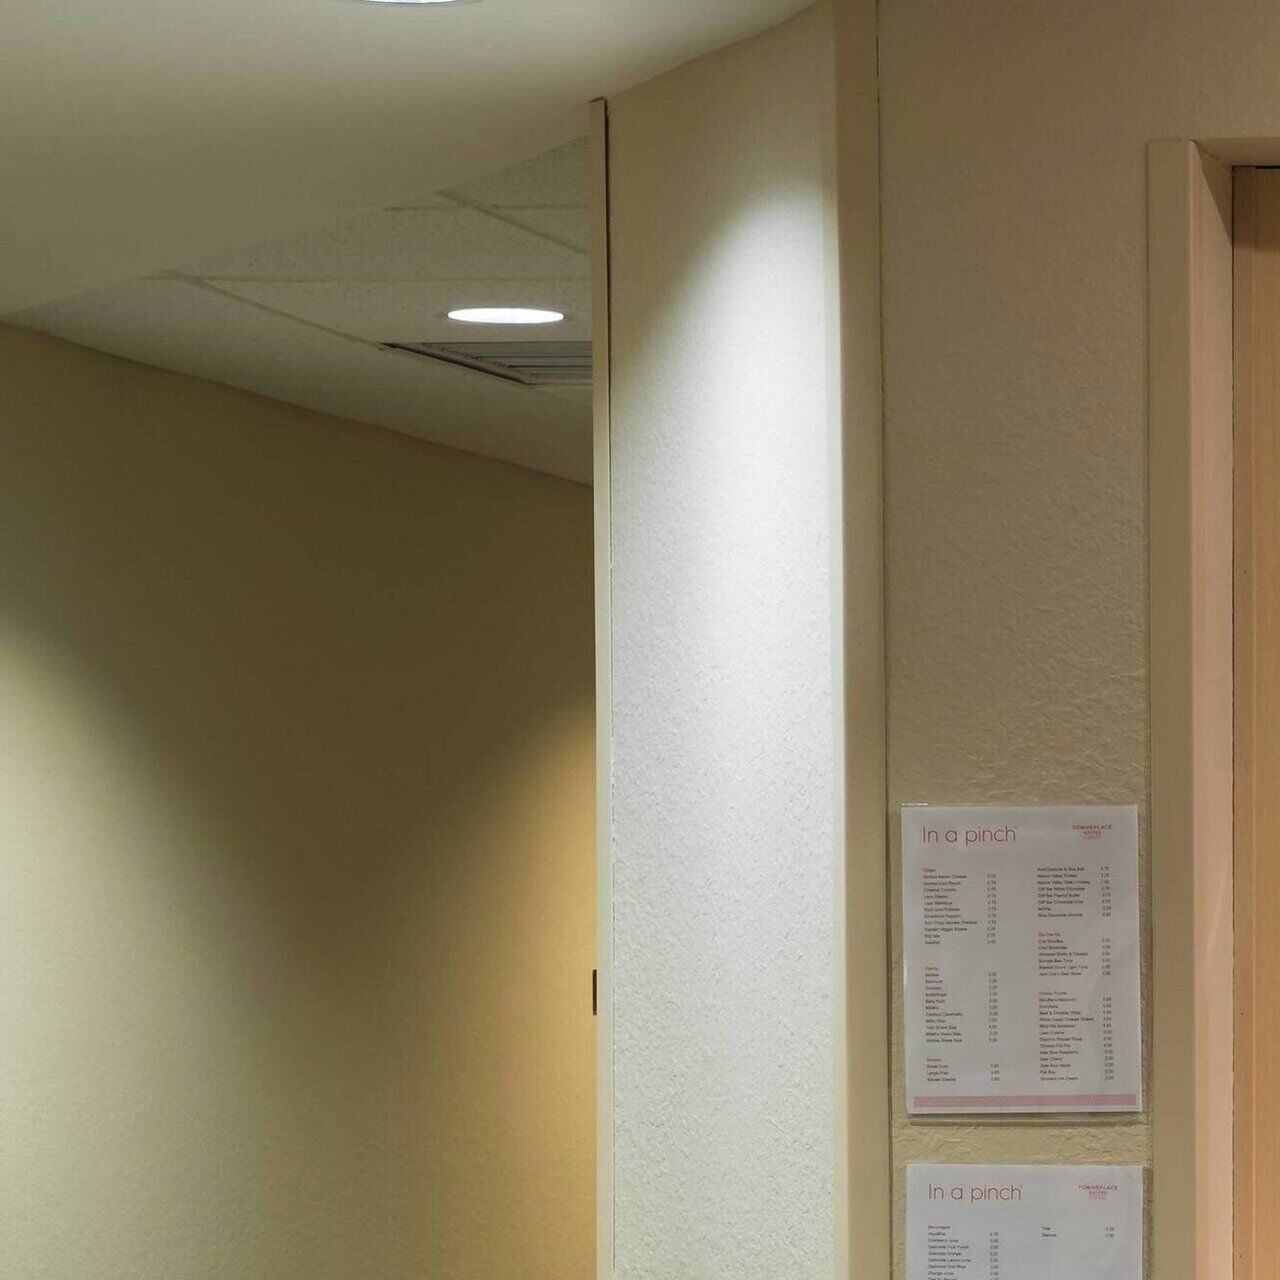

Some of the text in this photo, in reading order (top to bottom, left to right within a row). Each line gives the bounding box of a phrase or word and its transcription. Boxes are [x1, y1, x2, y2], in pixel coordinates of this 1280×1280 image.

[923, 825, 1017, 847] In a pinch
[929, 1183, 1021, 1204] In a pinch
